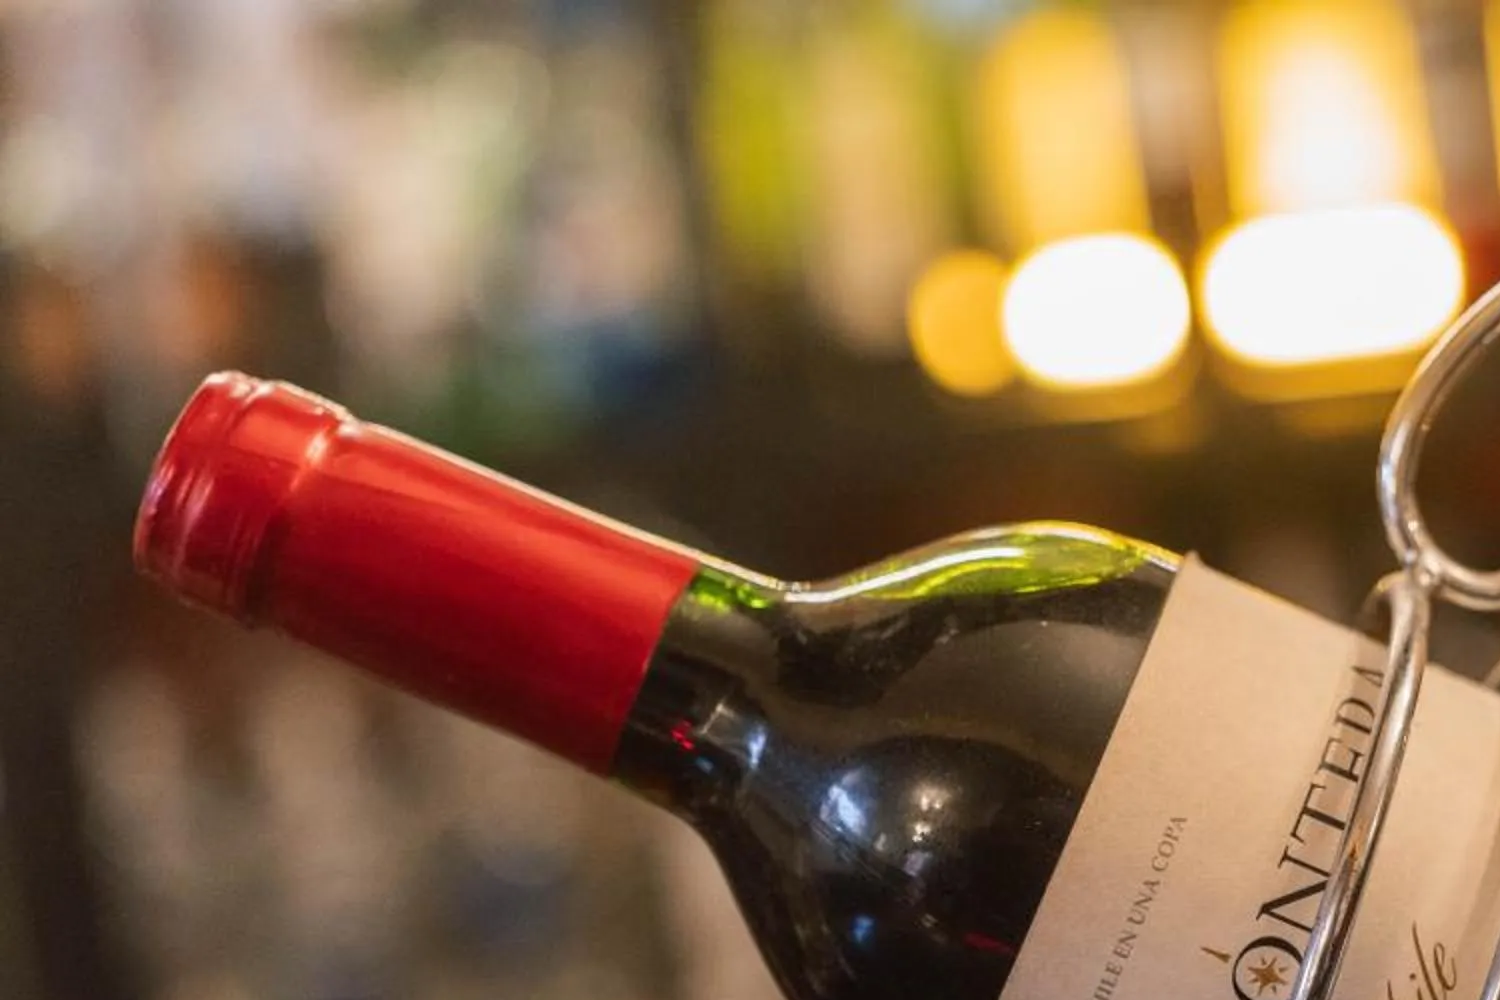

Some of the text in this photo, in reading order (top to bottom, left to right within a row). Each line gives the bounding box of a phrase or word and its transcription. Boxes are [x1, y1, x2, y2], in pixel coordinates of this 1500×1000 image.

[1113, 929, 1138, 959] EN
[1127, 880, 1161, 925] UNA
[1151, 816, 1188, 872] COPA
